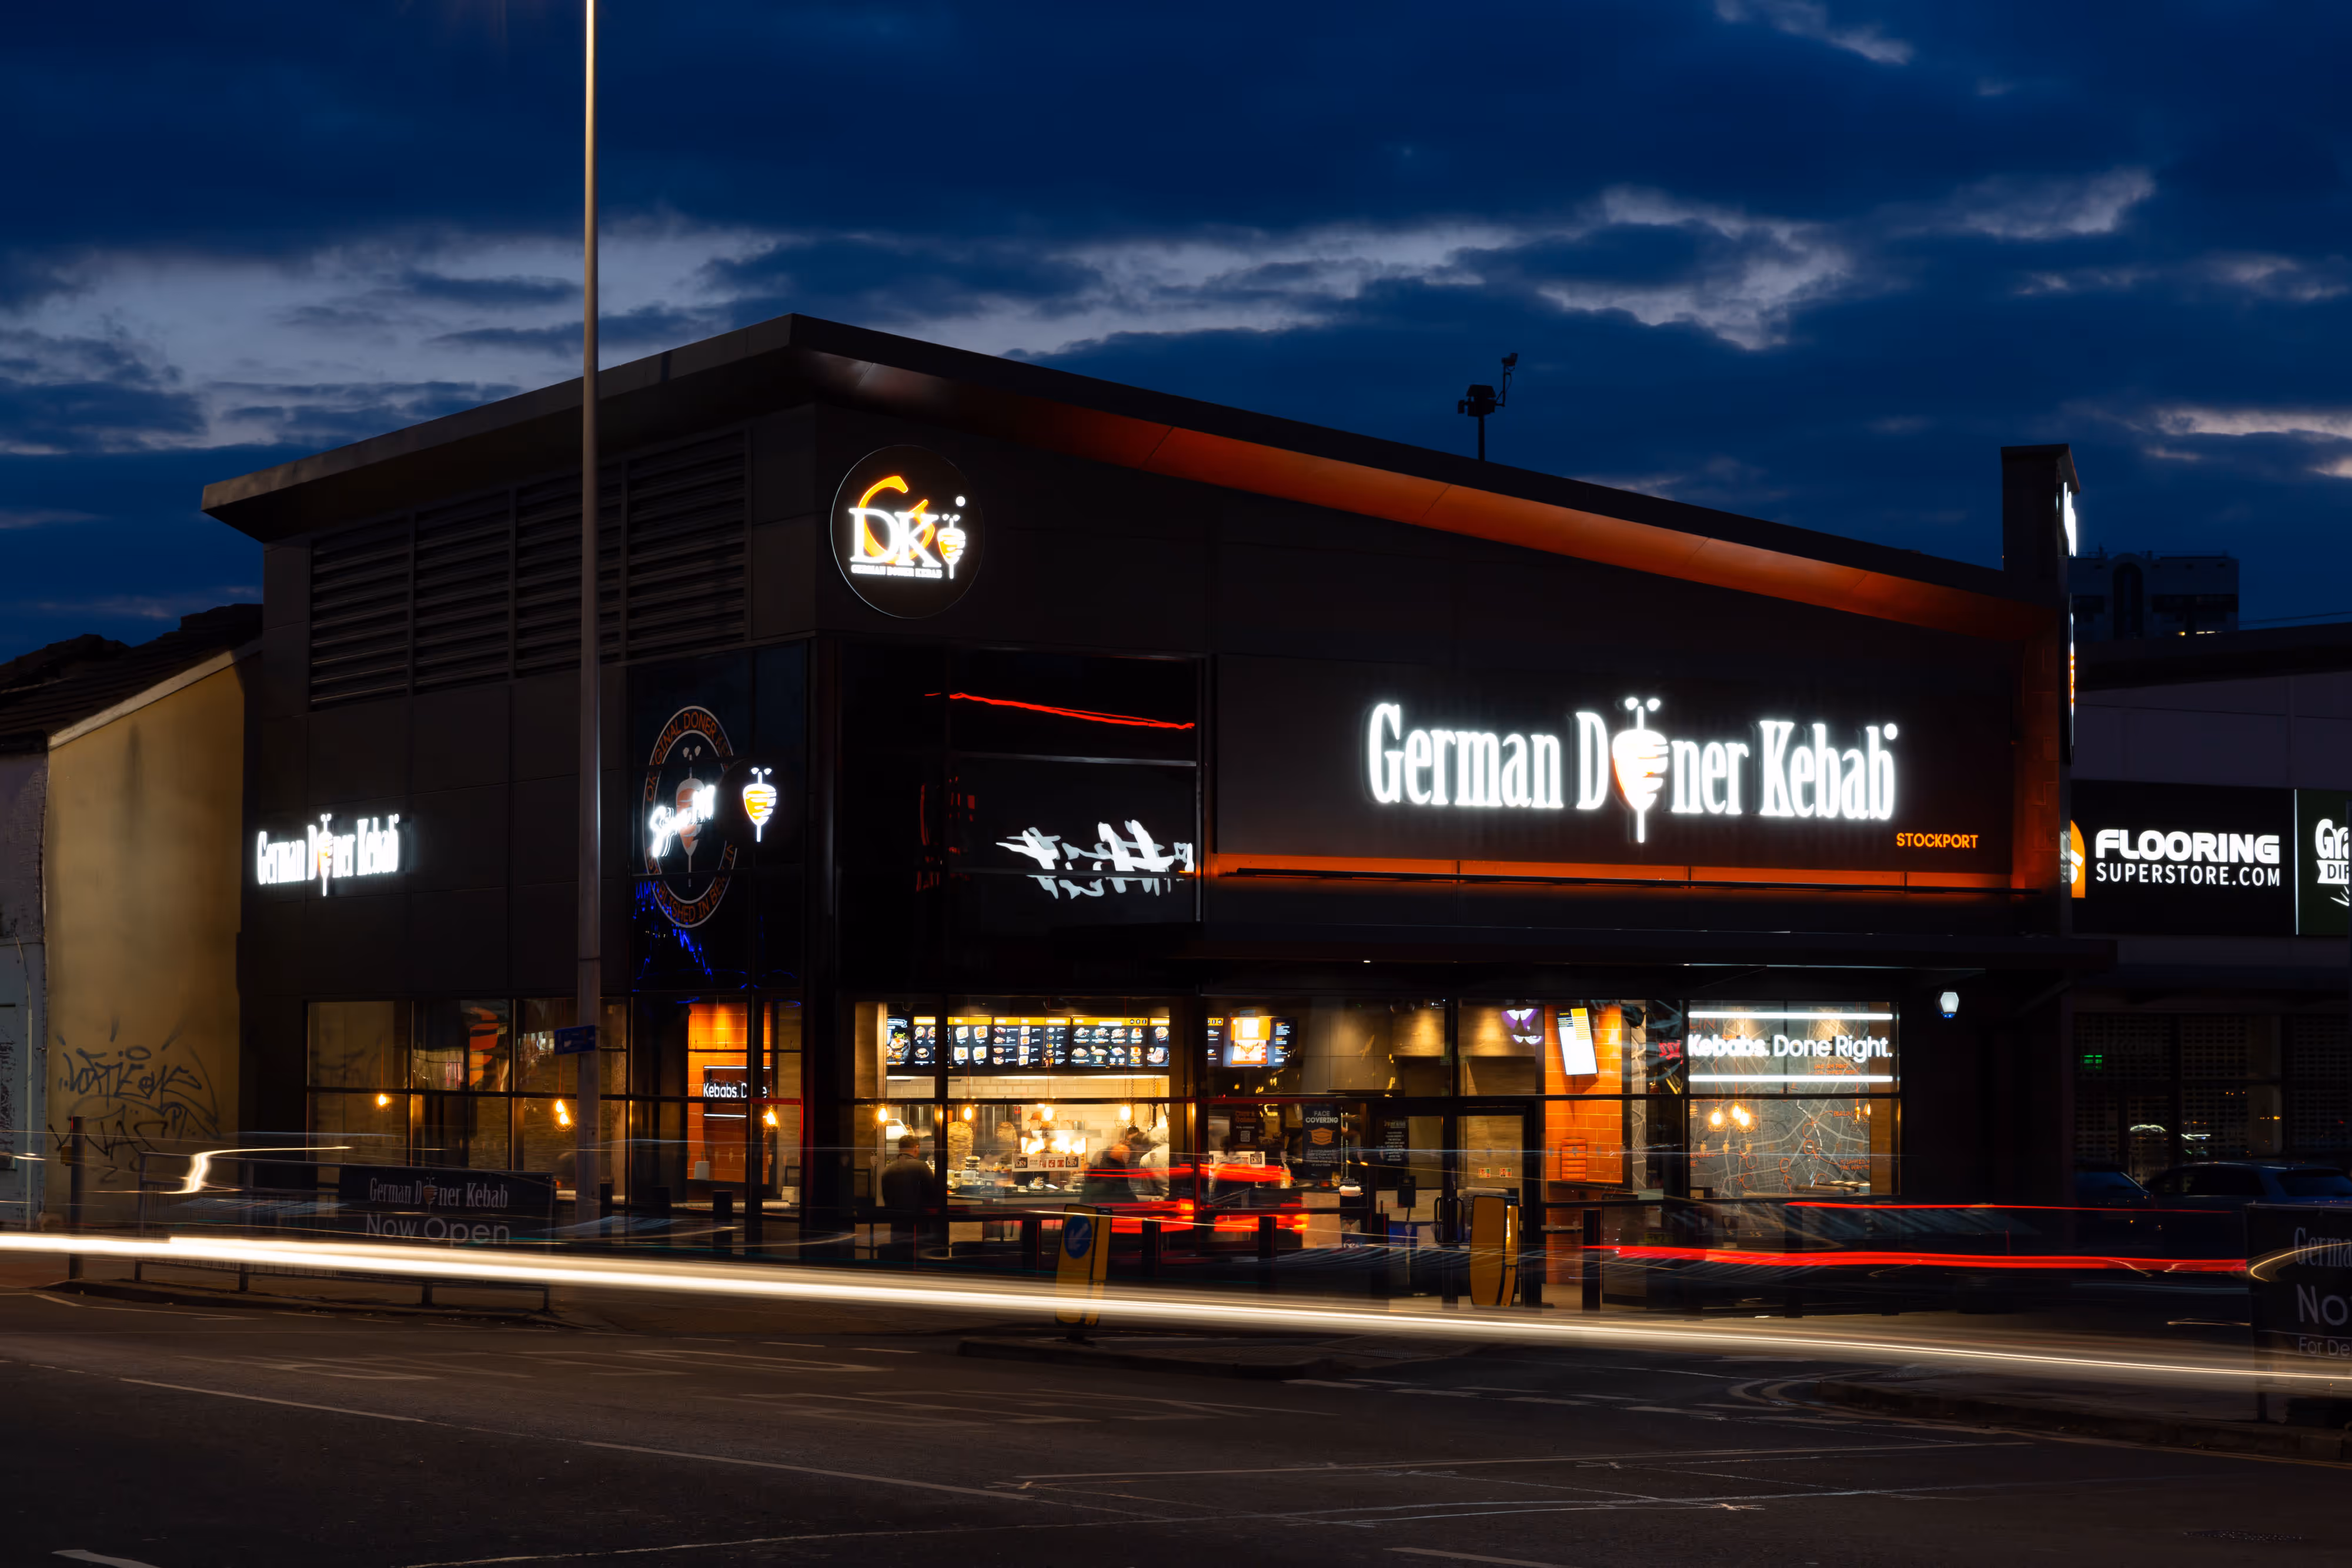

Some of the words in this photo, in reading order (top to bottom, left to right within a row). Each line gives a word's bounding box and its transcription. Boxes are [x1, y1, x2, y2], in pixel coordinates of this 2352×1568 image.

[646, 720, 682, 801] ORGINAL
[683, 711, 717, 739] DONER
[1369, 703, 1564, 810] German
[1759, 720, 1895, 820] Kebab
[1896, 833, 1978, 848] STOCKPORT
[2096, 829, 2280, 864] FLOORING
[258, 830, 306, 885] German
[2096, 862, 2280, 887] SUPERSTORE.COM
[1688, 1034, 1769, 1057] Kebabs.
[1773, 1035, 1830, 1057] Done
[1835, 1034, 1893, 1063] Right.
[703, 1082, 739, 1098] Kebabs.
[370, 1177, 412, 1204] German
[465, 1182, 509, 1209] Kebab
[366, 1213, 417, 1240] Now
[423, 1217, 510, 1247] Open
[2296, 1283, 2352, 1326] No
[2299, 1336, 2322, 1354] For
